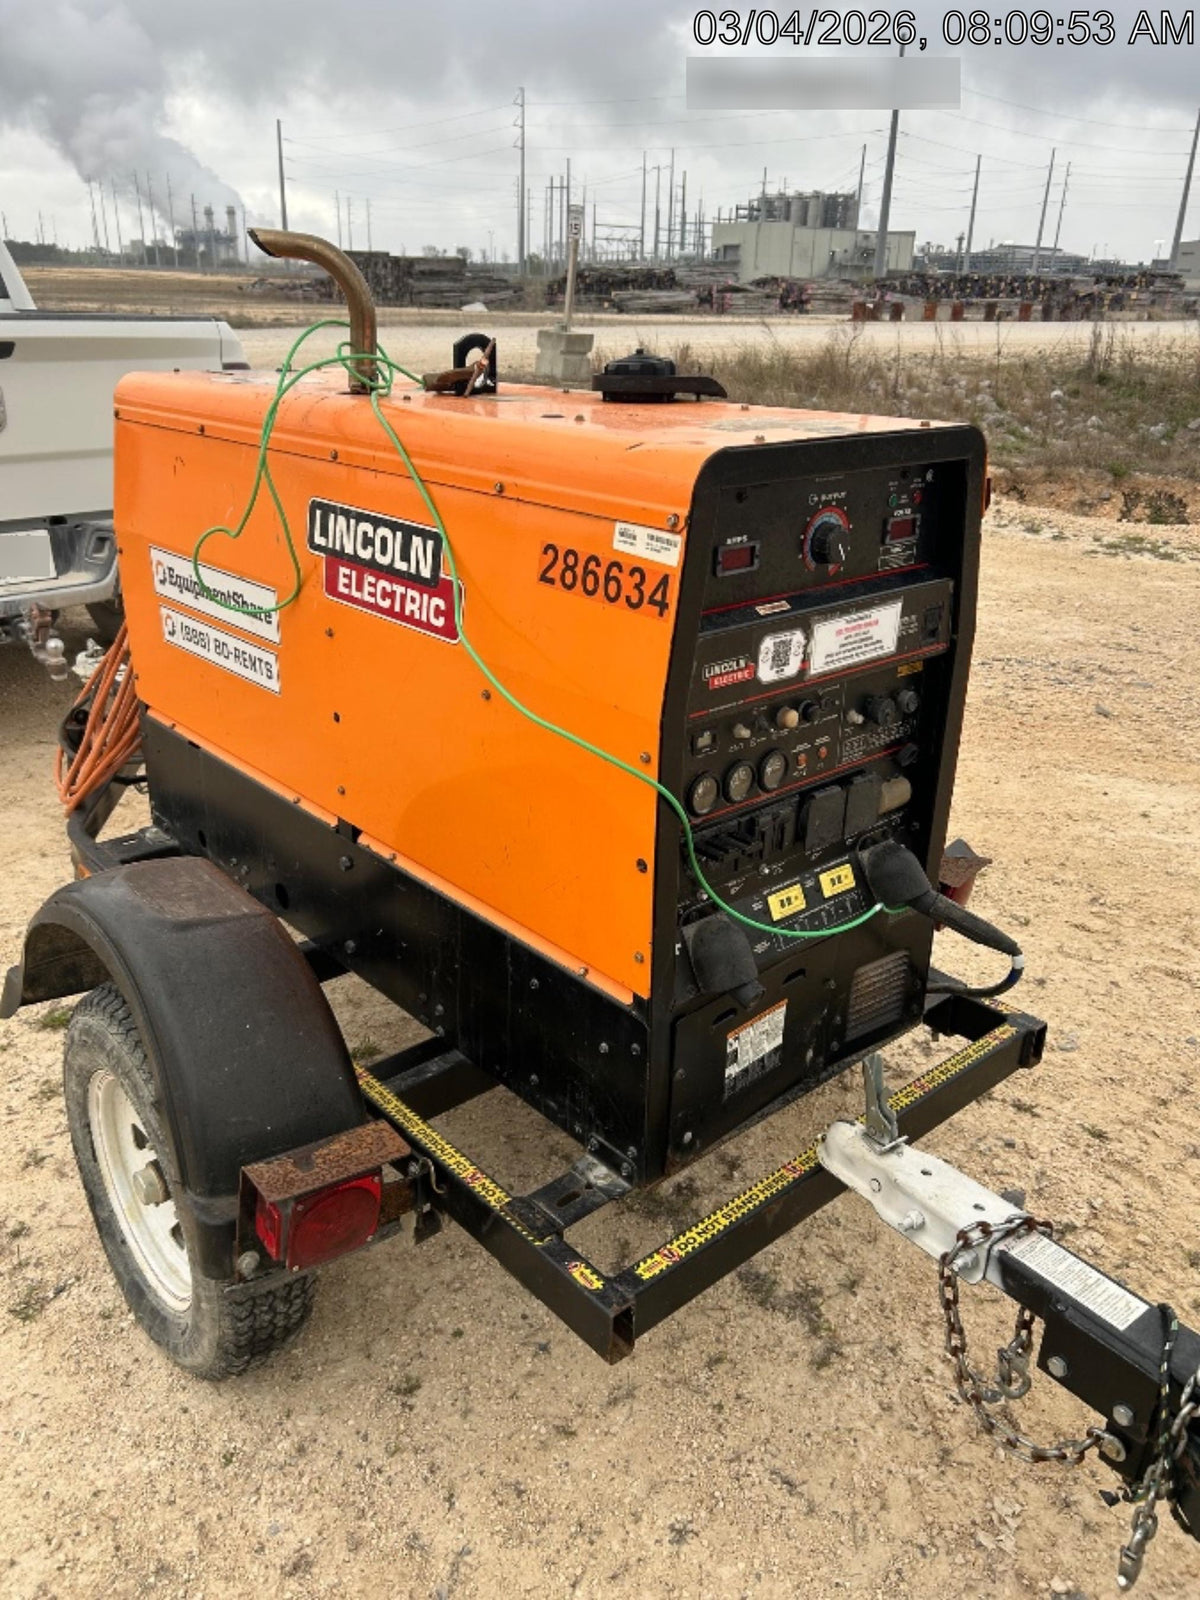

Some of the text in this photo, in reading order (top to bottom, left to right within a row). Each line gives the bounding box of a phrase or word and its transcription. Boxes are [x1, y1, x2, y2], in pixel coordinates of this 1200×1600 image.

[314, 509, 434, 579] LINCOLN
[337, 565, 446, 627] ELECTRIC
[539, 543, 670, 617] 286634
[705, 659, 746, 678] LINCOLN
[714, 668, 751, 685] ELECTRIC
[677, 1236, 697, 1251] DO
[695, 1217, 722, 1237] NOT
[721, 1192, 760, 1220] STAND
